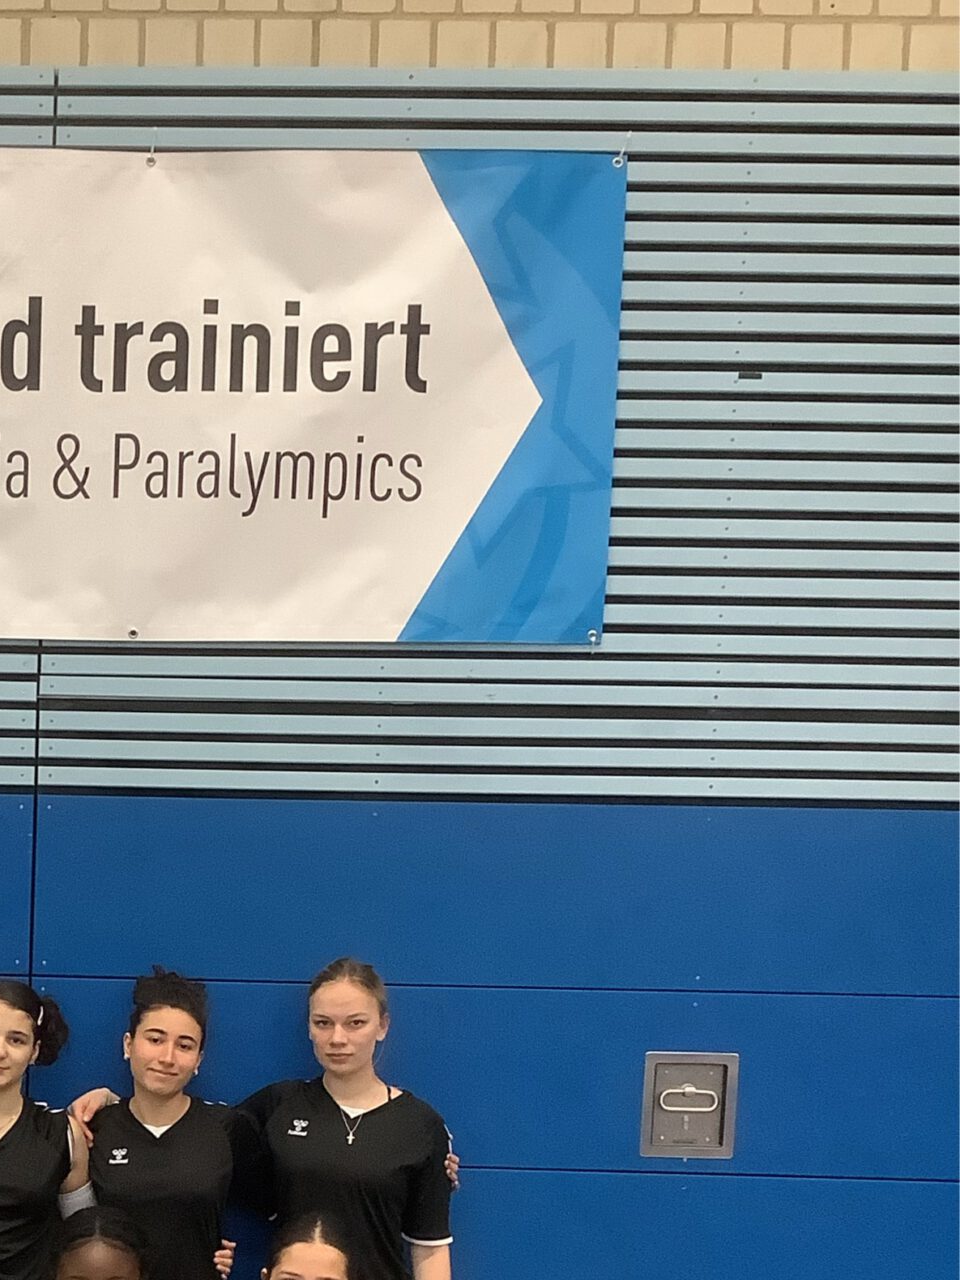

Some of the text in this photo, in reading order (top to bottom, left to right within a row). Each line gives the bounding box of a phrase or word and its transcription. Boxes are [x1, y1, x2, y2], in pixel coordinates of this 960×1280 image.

[75, 299, 430, 393] trainiert
[52, 433, 90, 499] &
[113, 433, 423, 518] Paralympics
